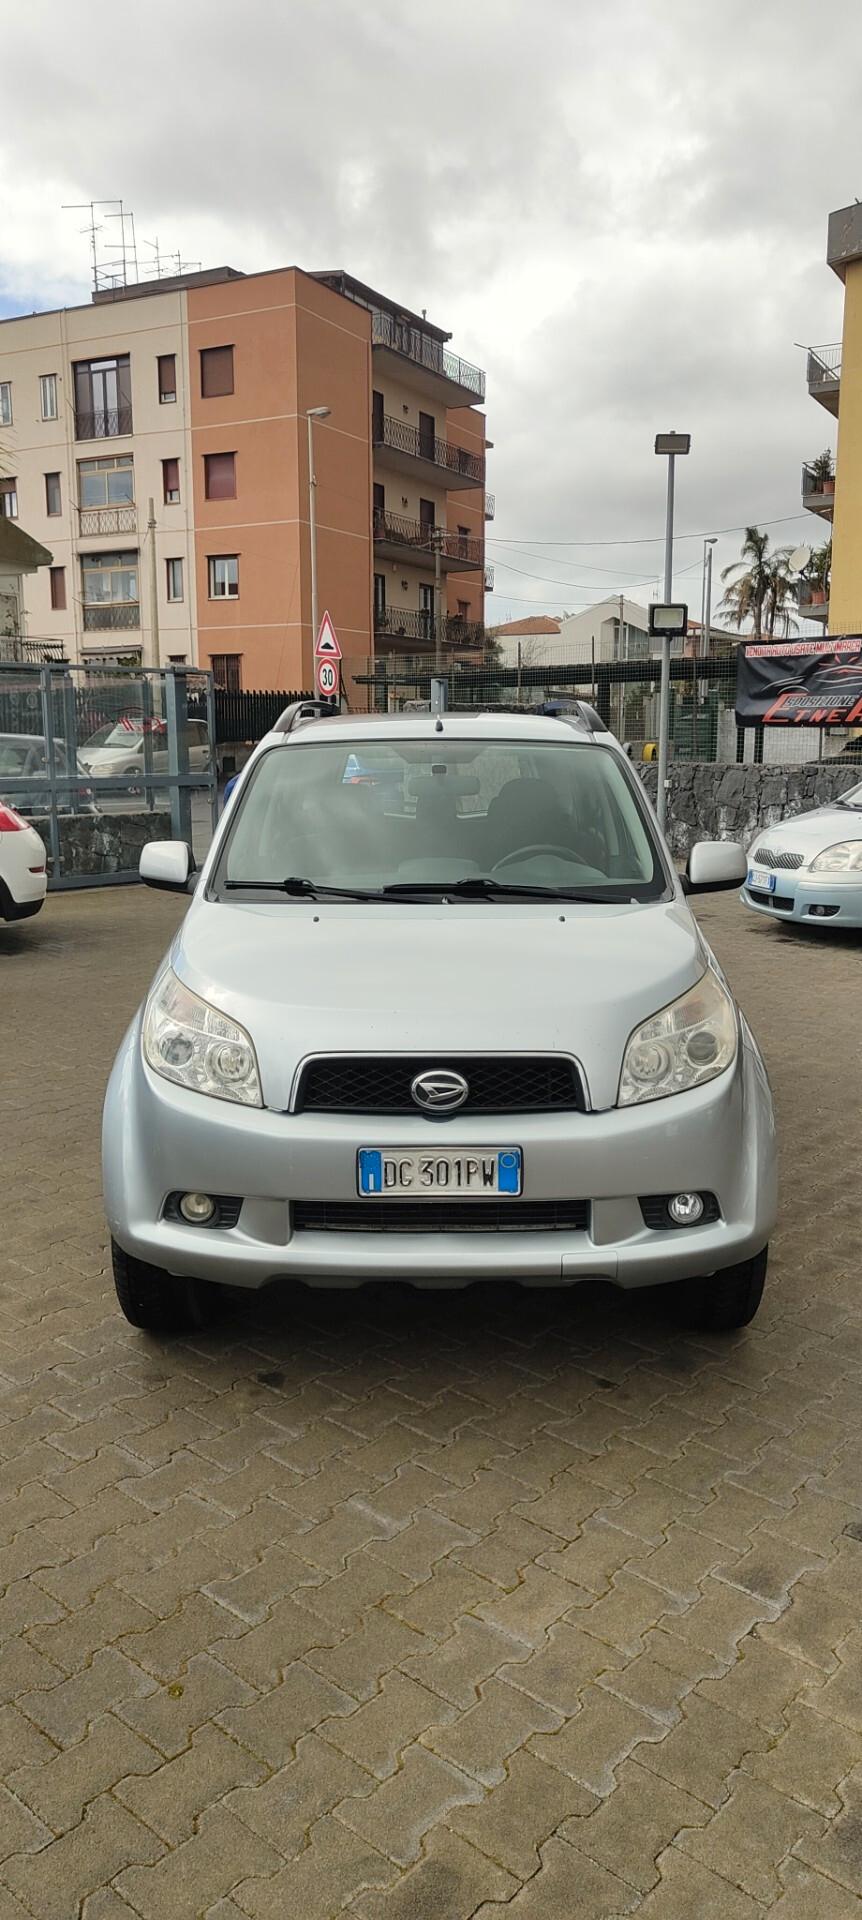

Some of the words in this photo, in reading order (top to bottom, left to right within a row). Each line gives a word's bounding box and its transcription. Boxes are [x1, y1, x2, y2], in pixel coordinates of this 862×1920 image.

[792, 643, 816, 655] USATE
[322, 669, 333, 686] 30
[420, 1157, 495, 1187] 301PW
